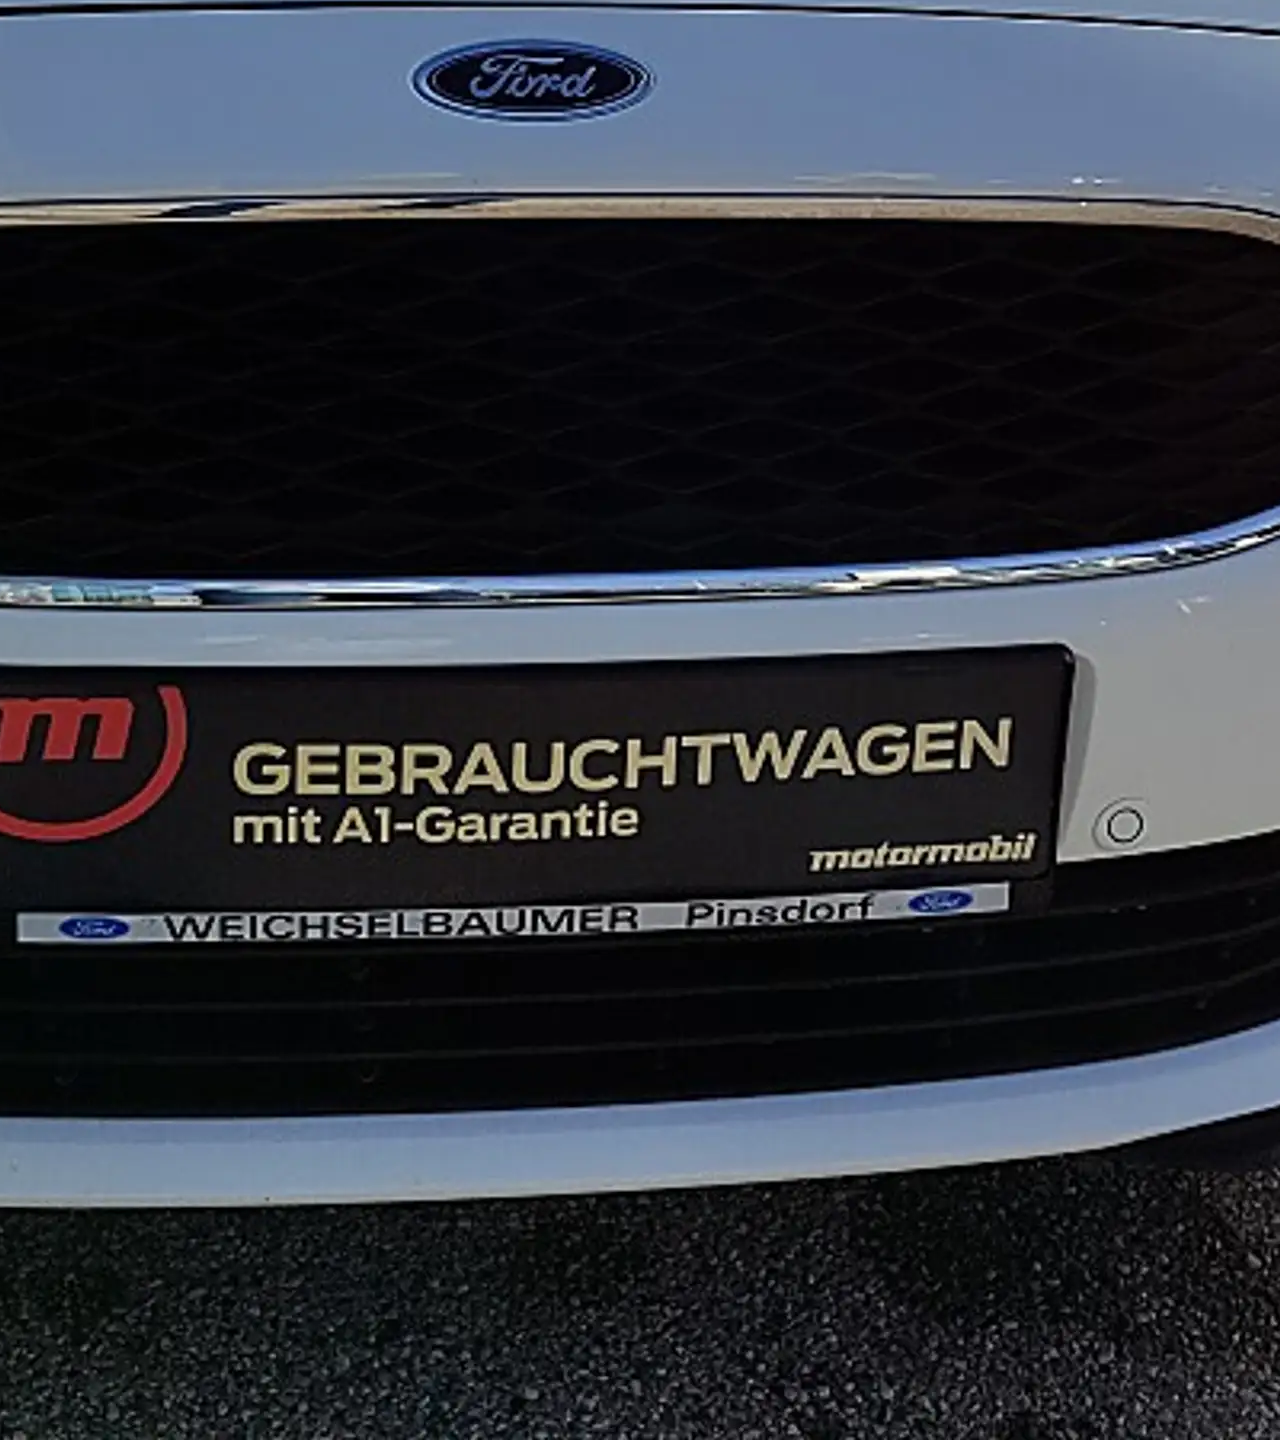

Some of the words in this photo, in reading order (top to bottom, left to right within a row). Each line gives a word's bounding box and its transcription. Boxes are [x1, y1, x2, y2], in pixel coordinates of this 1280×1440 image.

[469, 54, 597, 98] Ford
[232, 717, 1013, 797] GEBRAUCHTWAGEN
[232, 806, 322, 845] mit
[332, 800, 640, 845] A1-Garantie
[808, 832, 1038, 873] motormobil
[164, 905, 640, 940] WEICHSELBAUMER
[686, 893, 876, 927] Pinsdorf
